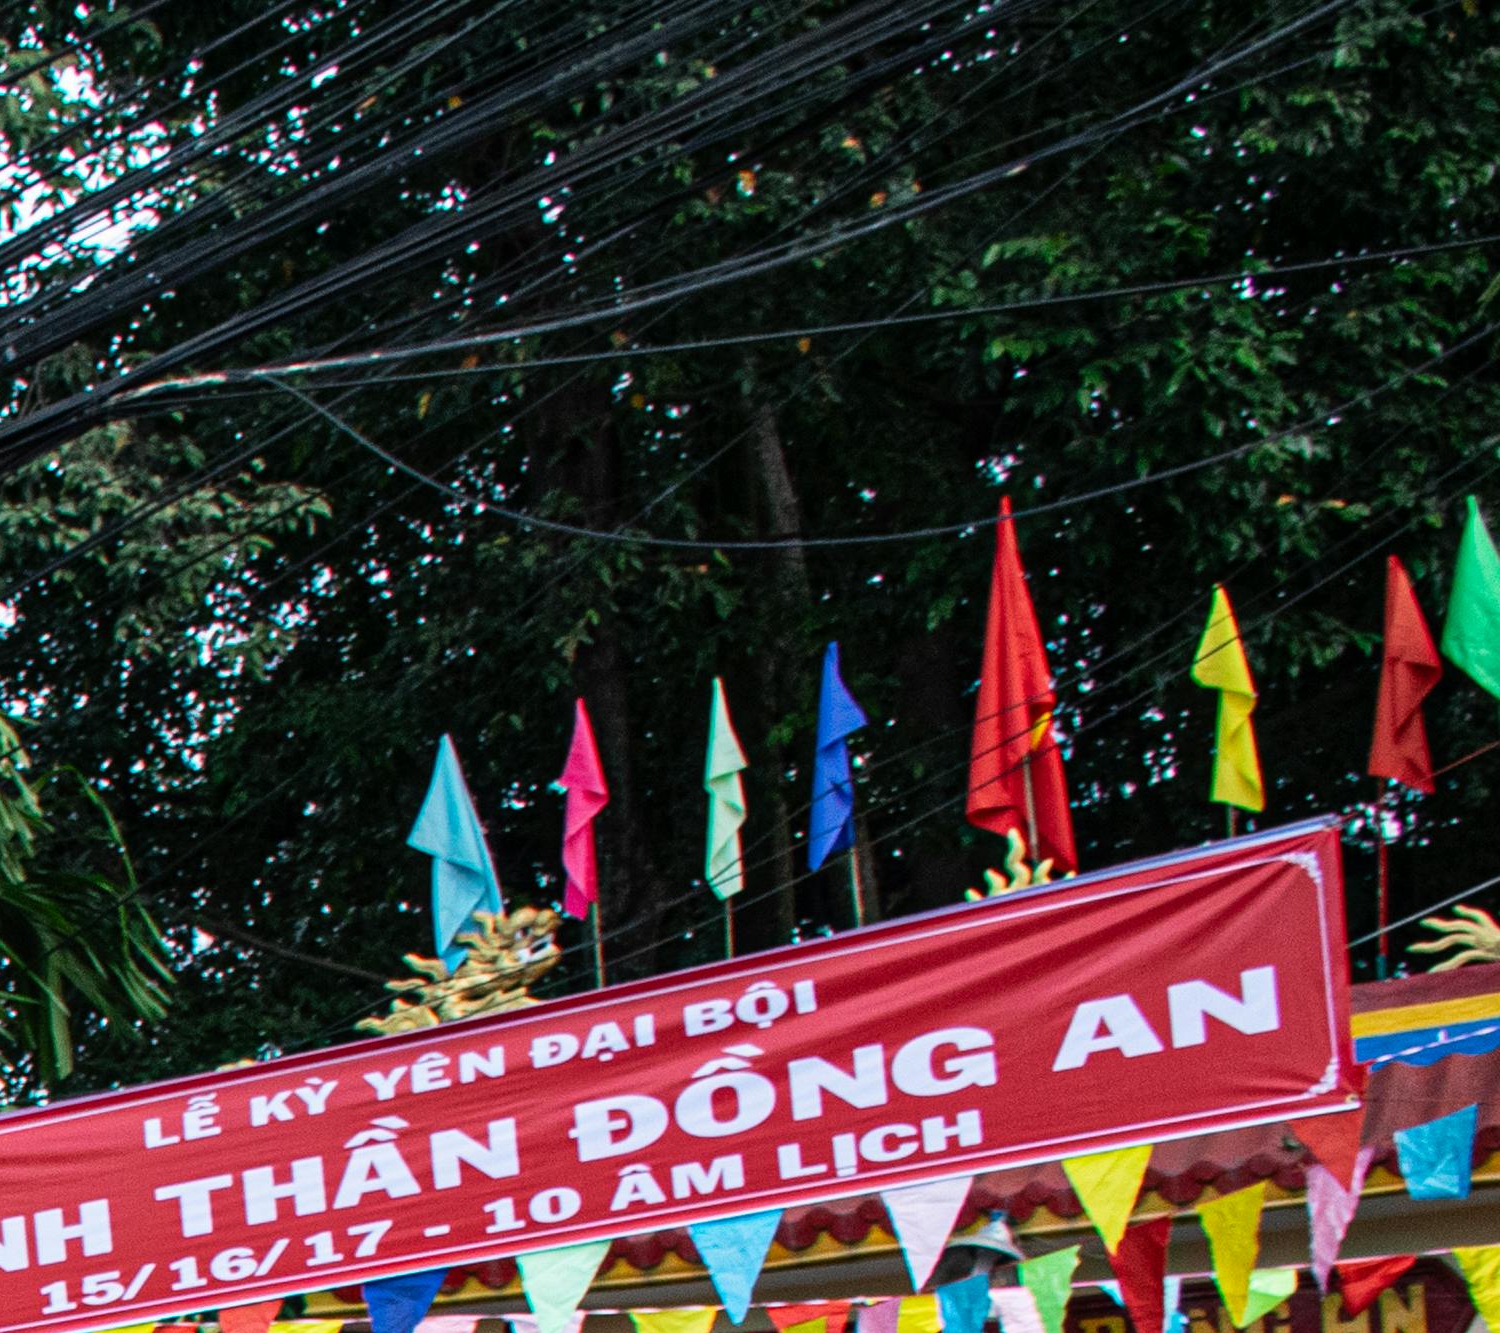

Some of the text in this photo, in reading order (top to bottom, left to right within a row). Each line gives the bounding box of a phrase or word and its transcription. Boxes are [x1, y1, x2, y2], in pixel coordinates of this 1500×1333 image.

[144, 980, 817, 1149] LỄ KỲ YÊN ĐẠI BỘI
[155, 1115, 520, 1237] THẦN
[569, 1026, 997, 1163] ĐỒNG
[1052, 964, 1280, 1072] AN
[39, 1219, 392, 1316] 15/16/17
[484, 1188, 580, 1236] 10
[610, 1154, 745, 1213] ÂM
[777, 1110, 982, 1179] LỊCH
